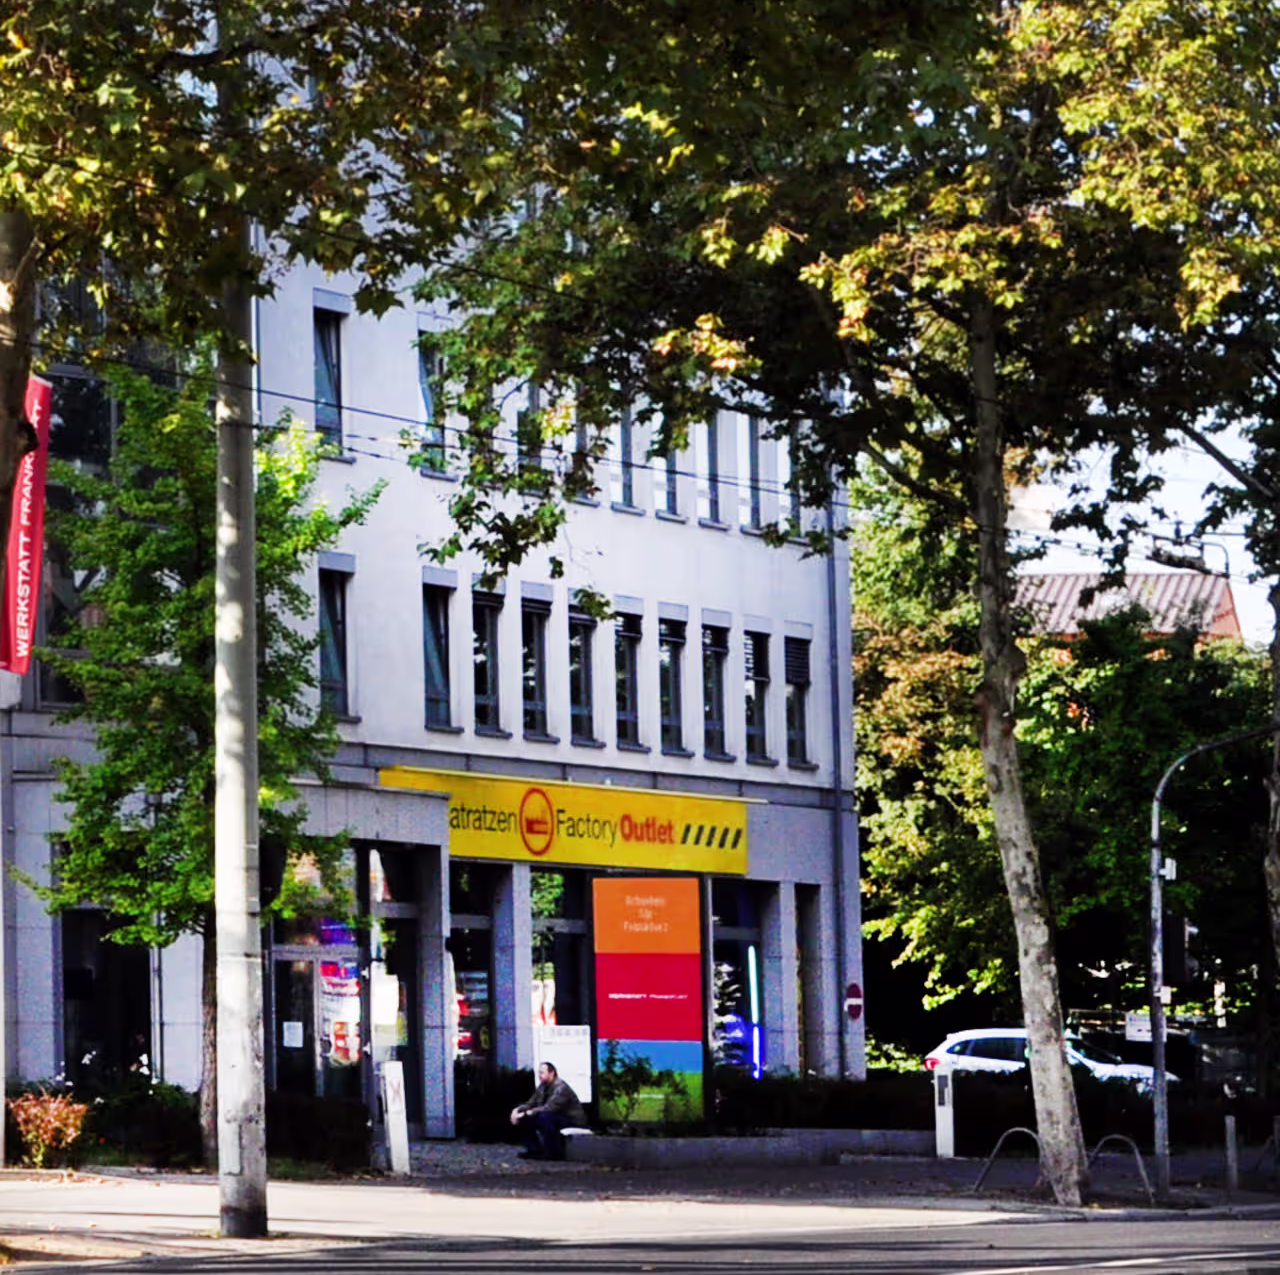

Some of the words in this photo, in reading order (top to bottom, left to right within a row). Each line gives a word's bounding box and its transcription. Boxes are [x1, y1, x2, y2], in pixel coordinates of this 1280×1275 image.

[16, 530, 32, 658] WERKSTATT
[449, 804, 517, 833] atratzen
[557, 808, 618, 846] Factory
[620, 813, 675, 845] Outlet
